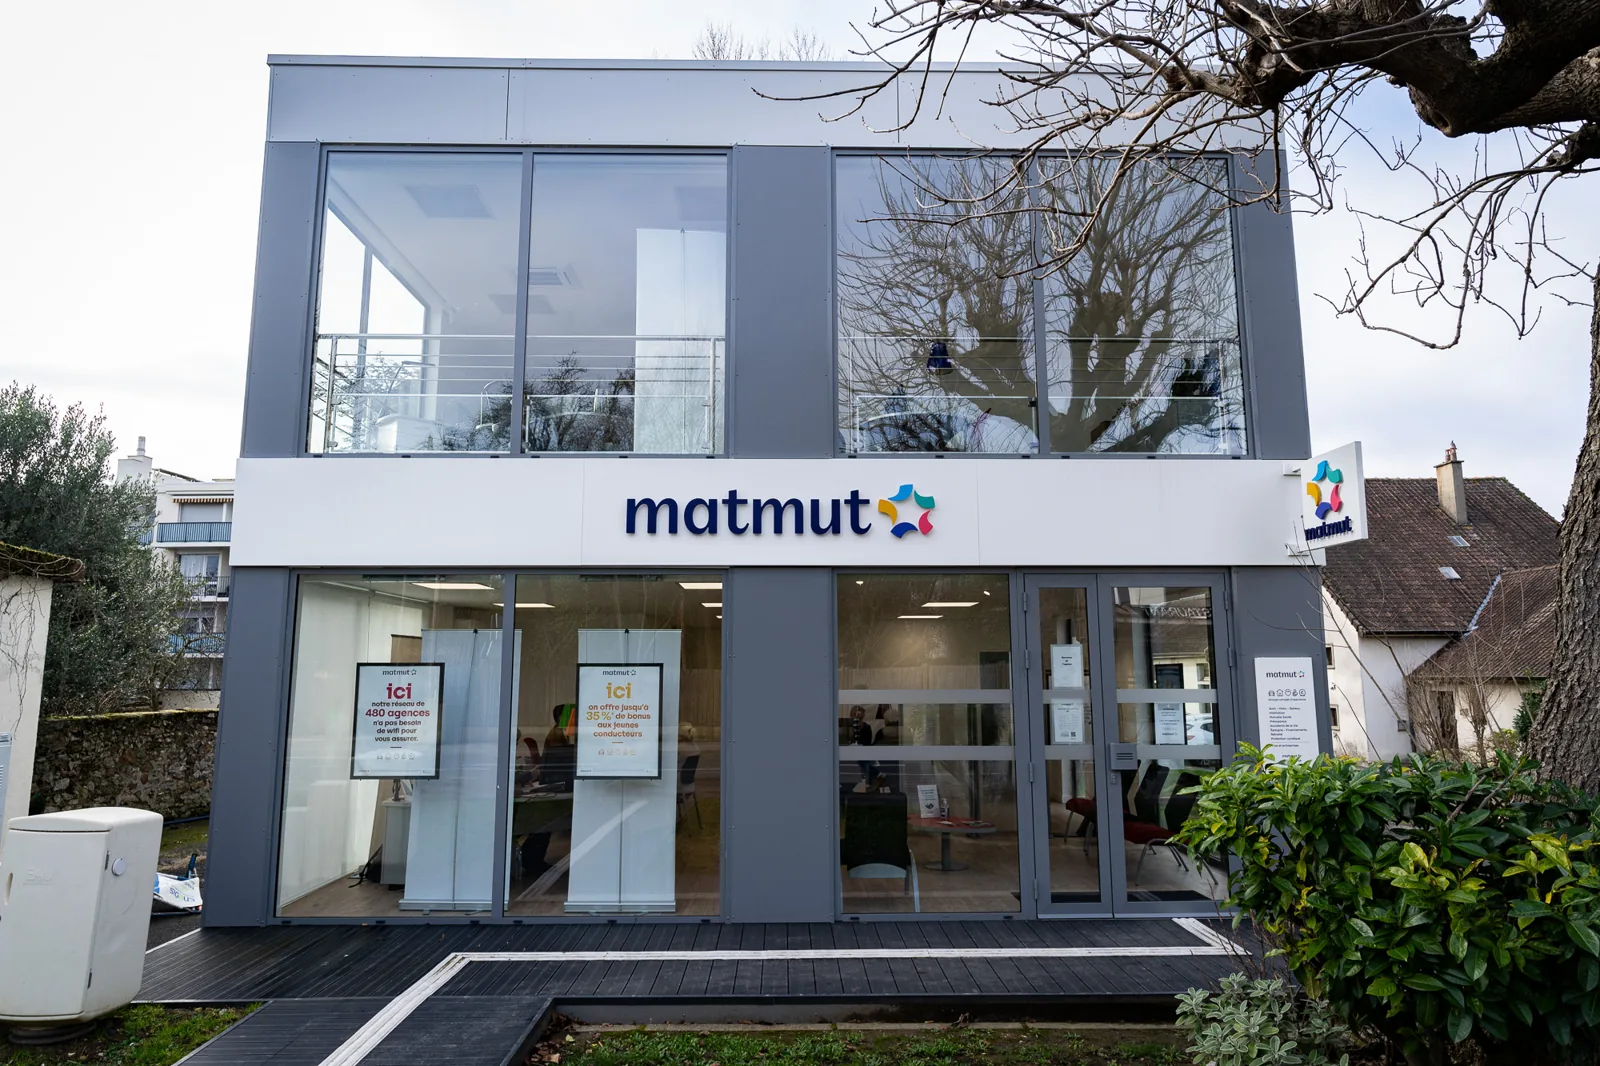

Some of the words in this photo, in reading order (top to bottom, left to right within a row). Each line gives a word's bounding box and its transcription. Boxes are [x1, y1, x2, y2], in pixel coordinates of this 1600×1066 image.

[626, 489, 872, 535] matmut
[1305, 516, 1352, 541] matmut
[386, 682, 412, 699] ici
[606, 682, 632, 699] ici
[365, 708, 385, 717] 480
[387, 710, 430, 719] agences
[613, 721, 639, 729] jeunes
